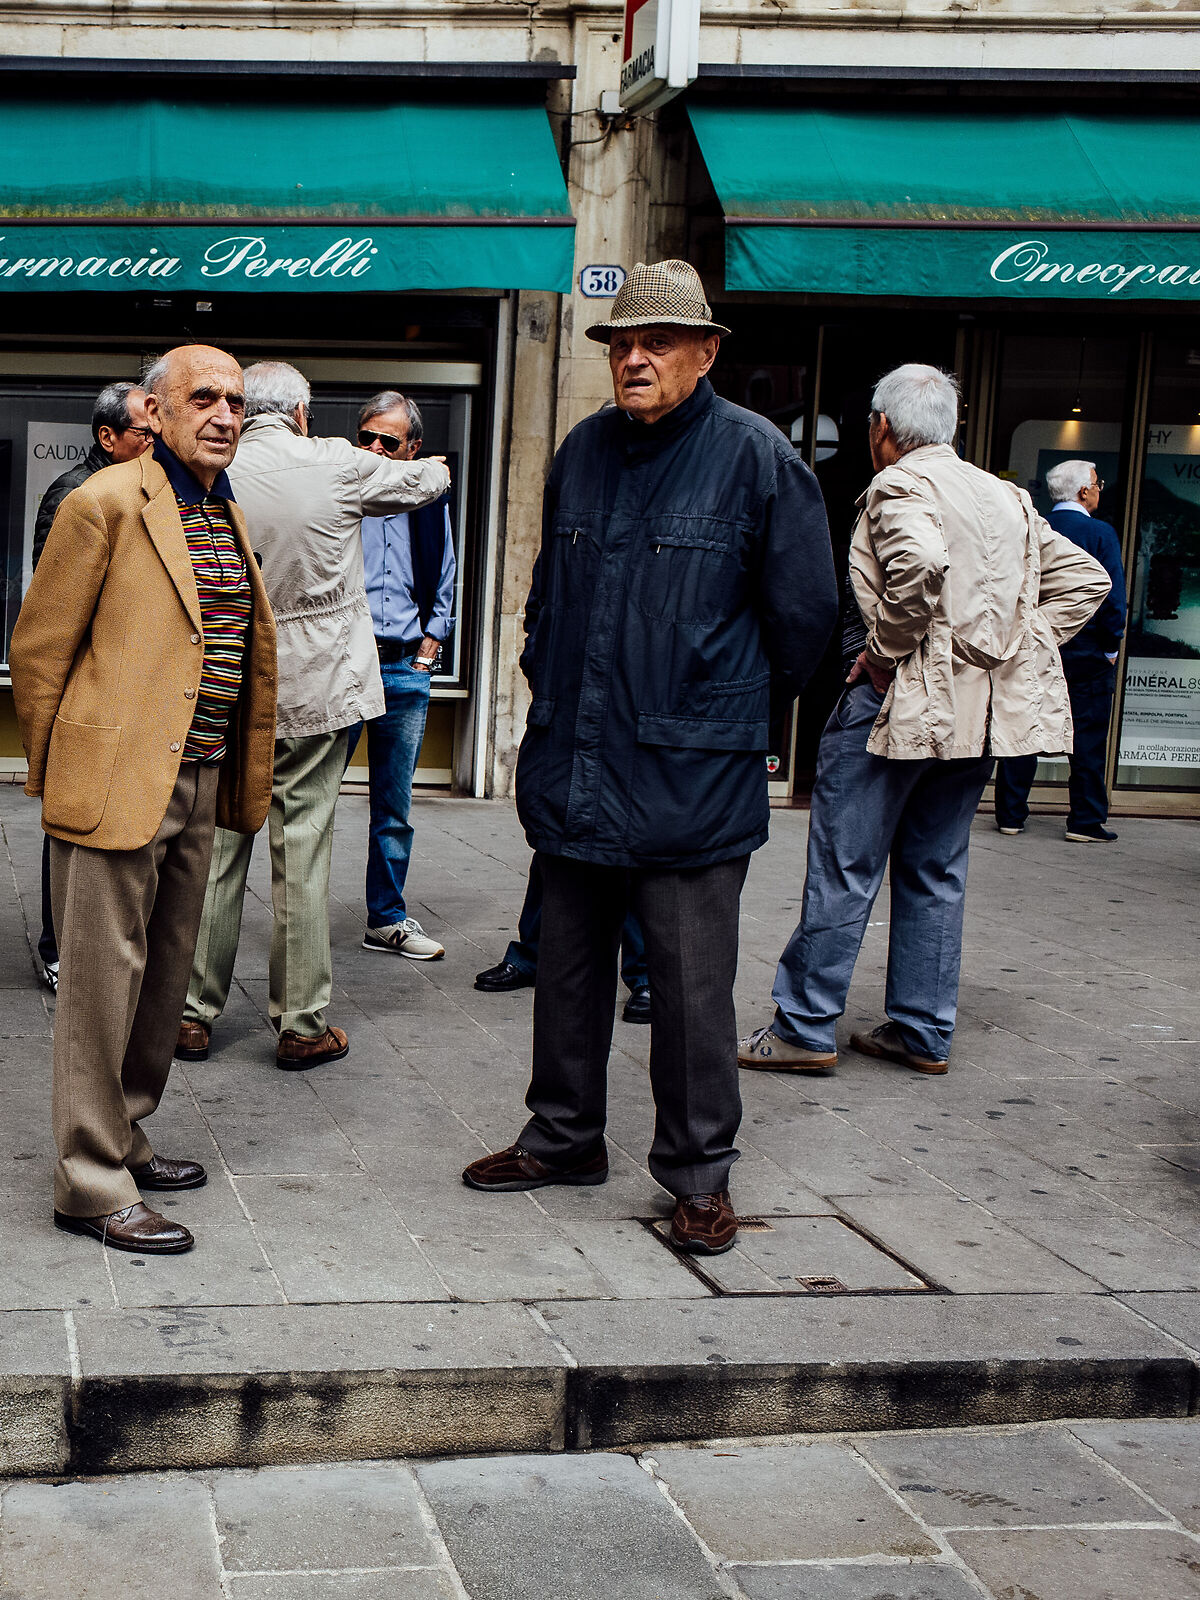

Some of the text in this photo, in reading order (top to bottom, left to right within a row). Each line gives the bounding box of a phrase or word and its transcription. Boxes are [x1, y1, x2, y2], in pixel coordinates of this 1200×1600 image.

[620, 45, 655, 95] FARMACIA
[200, 235, 378, 278] Perelli
[589, 271, 618, 292] 38
[33, 443, 91, 460] CAUDA
